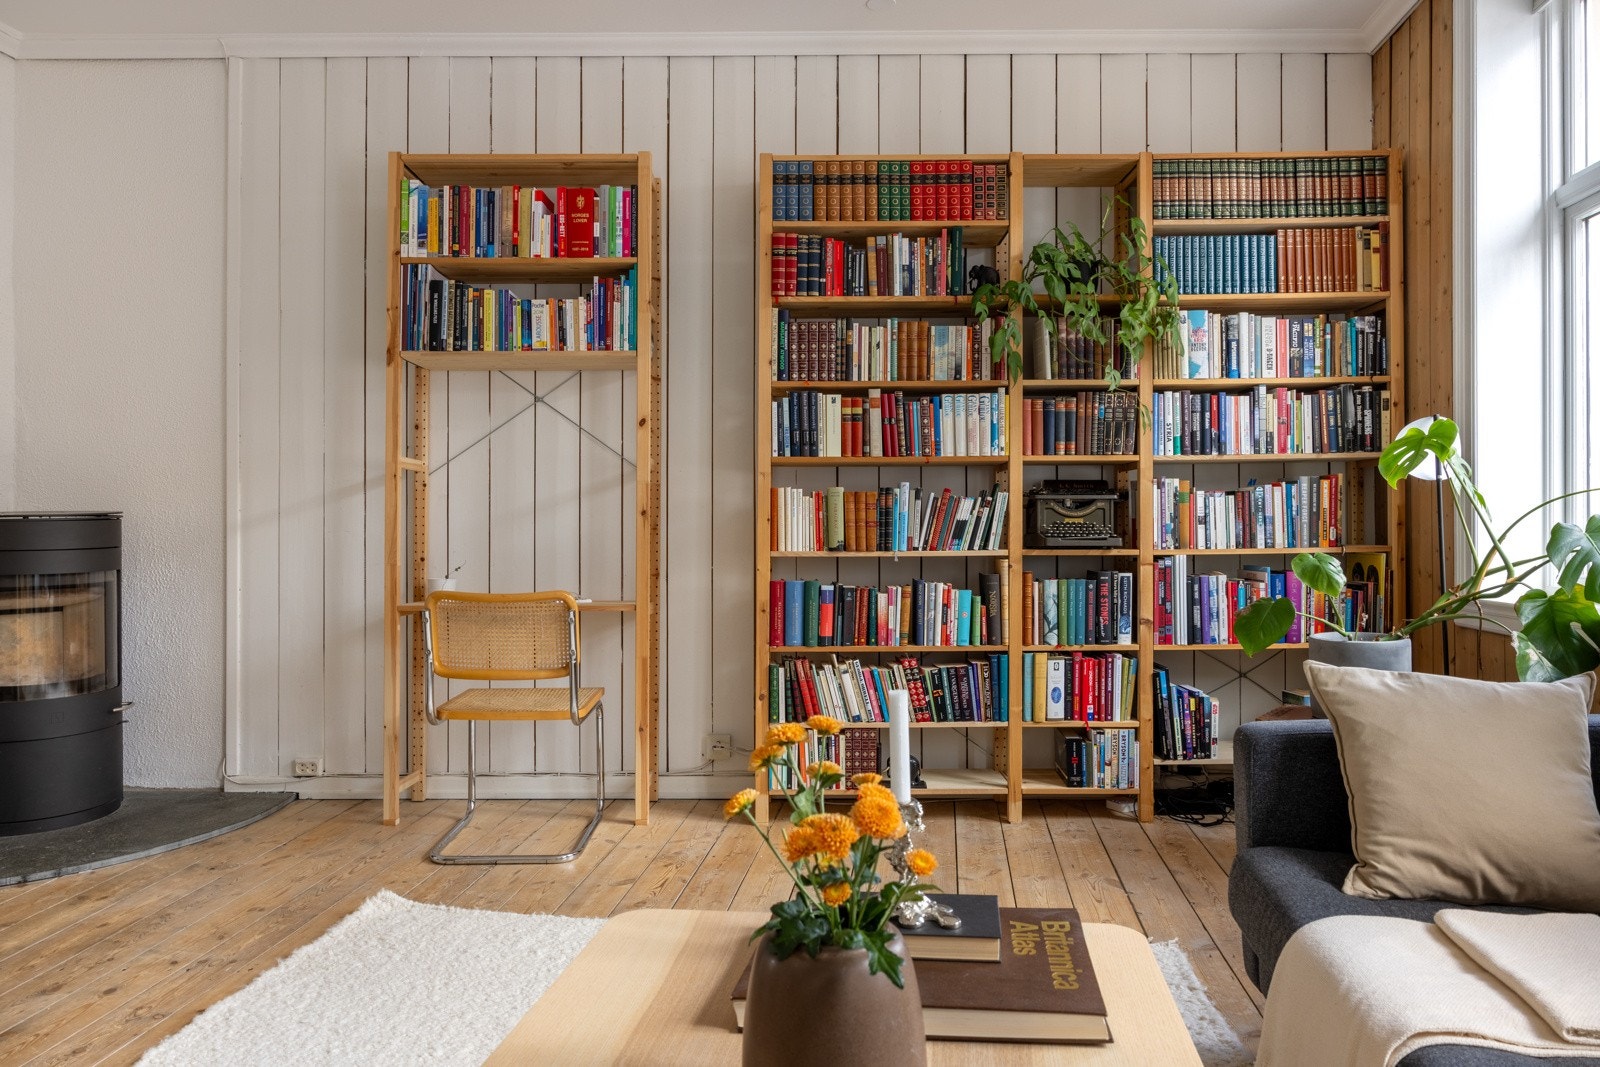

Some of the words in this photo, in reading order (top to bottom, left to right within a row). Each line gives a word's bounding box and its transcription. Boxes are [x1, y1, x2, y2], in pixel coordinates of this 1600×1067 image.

[1100, 582, 1109, 596] THE
[989, 590, 997, 618] NARNIA
[1100, 598, 1109, 625] STONES
[1009, 920, 1041, 956] Atlas
[1041, 920, 1083, 990] Britannica
